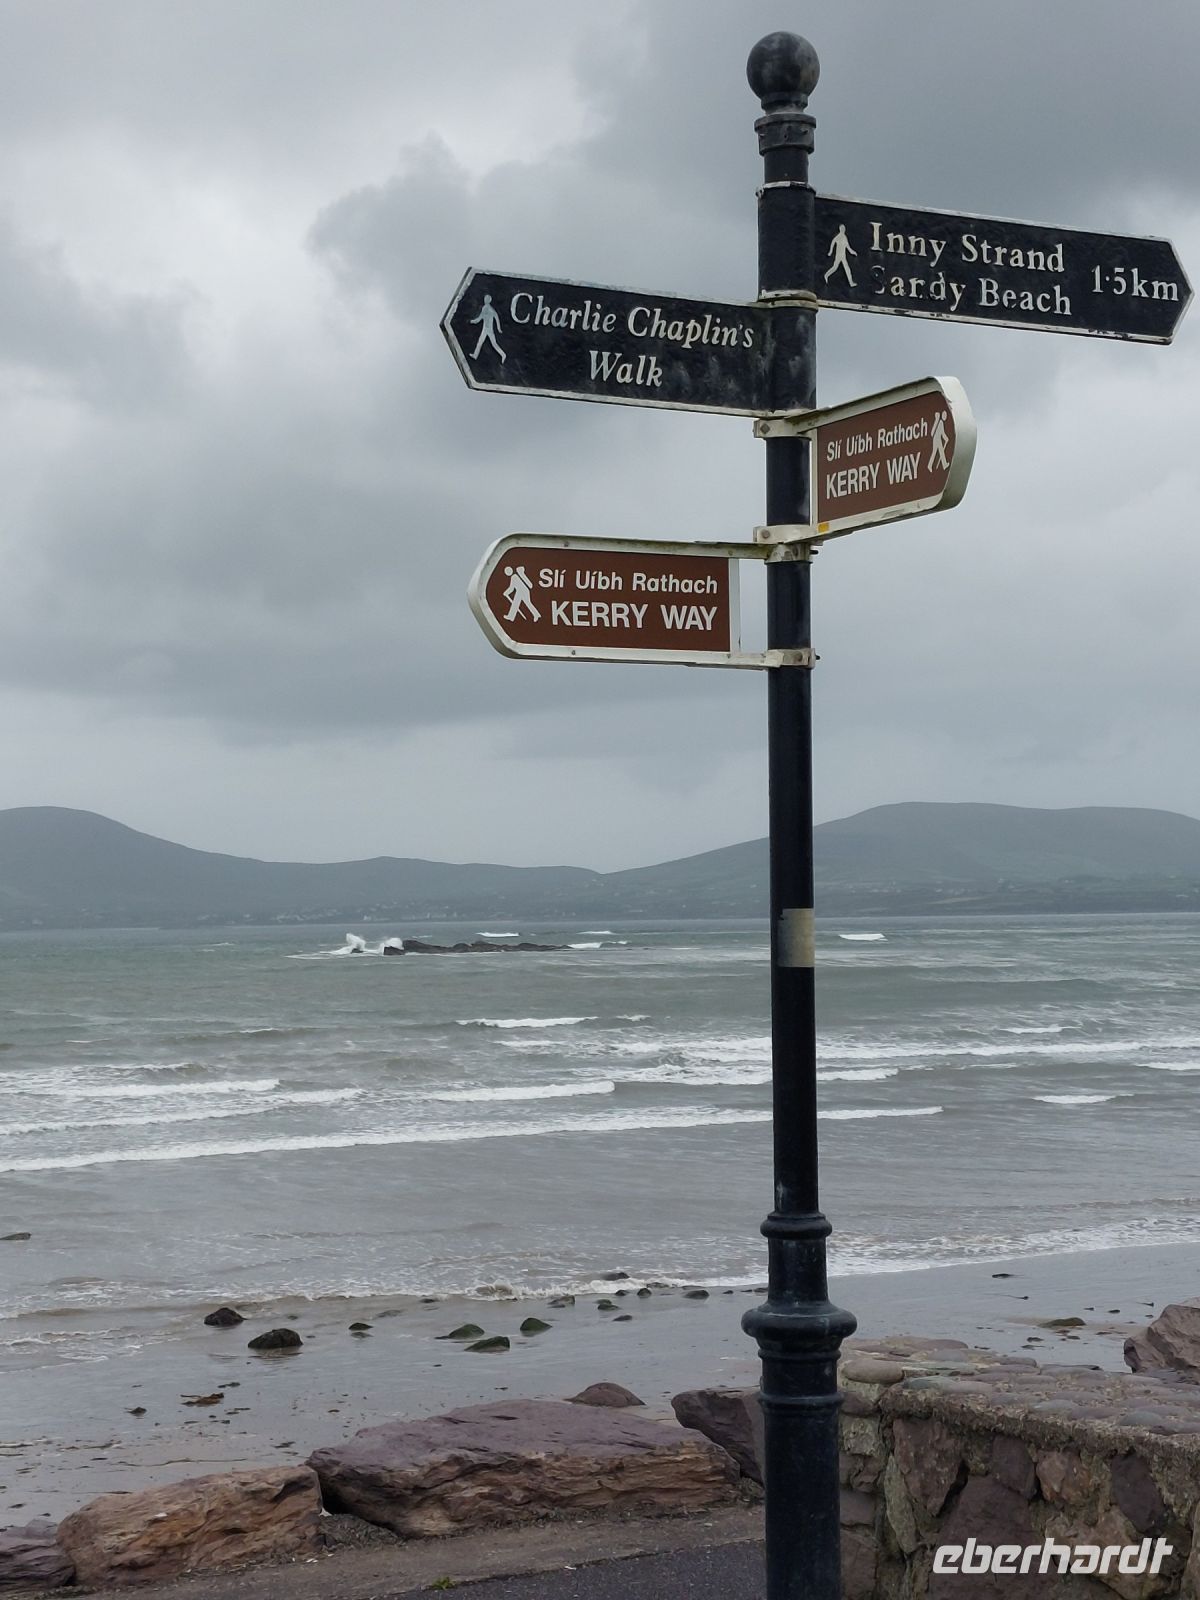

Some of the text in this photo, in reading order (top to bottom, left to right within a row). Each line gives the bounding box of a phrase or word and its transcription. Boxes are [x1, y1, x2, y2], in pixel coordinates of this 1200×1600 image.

[869, 221, 1065, 273] Inny Strand
[979, 277, 1073, 316] Beach
[510, 293, 754, 349] Charlie Chaplin's
[588, 350, 663, 388] Walk
[826, 417, 928, 462] Slí Uíbh Rathach
[826, 452, 921, 500] KERRY WAY
[538, 568, 718, 595] Slí Uíbh Rathach
[551, 601, 718, 631] KERRY WAY
